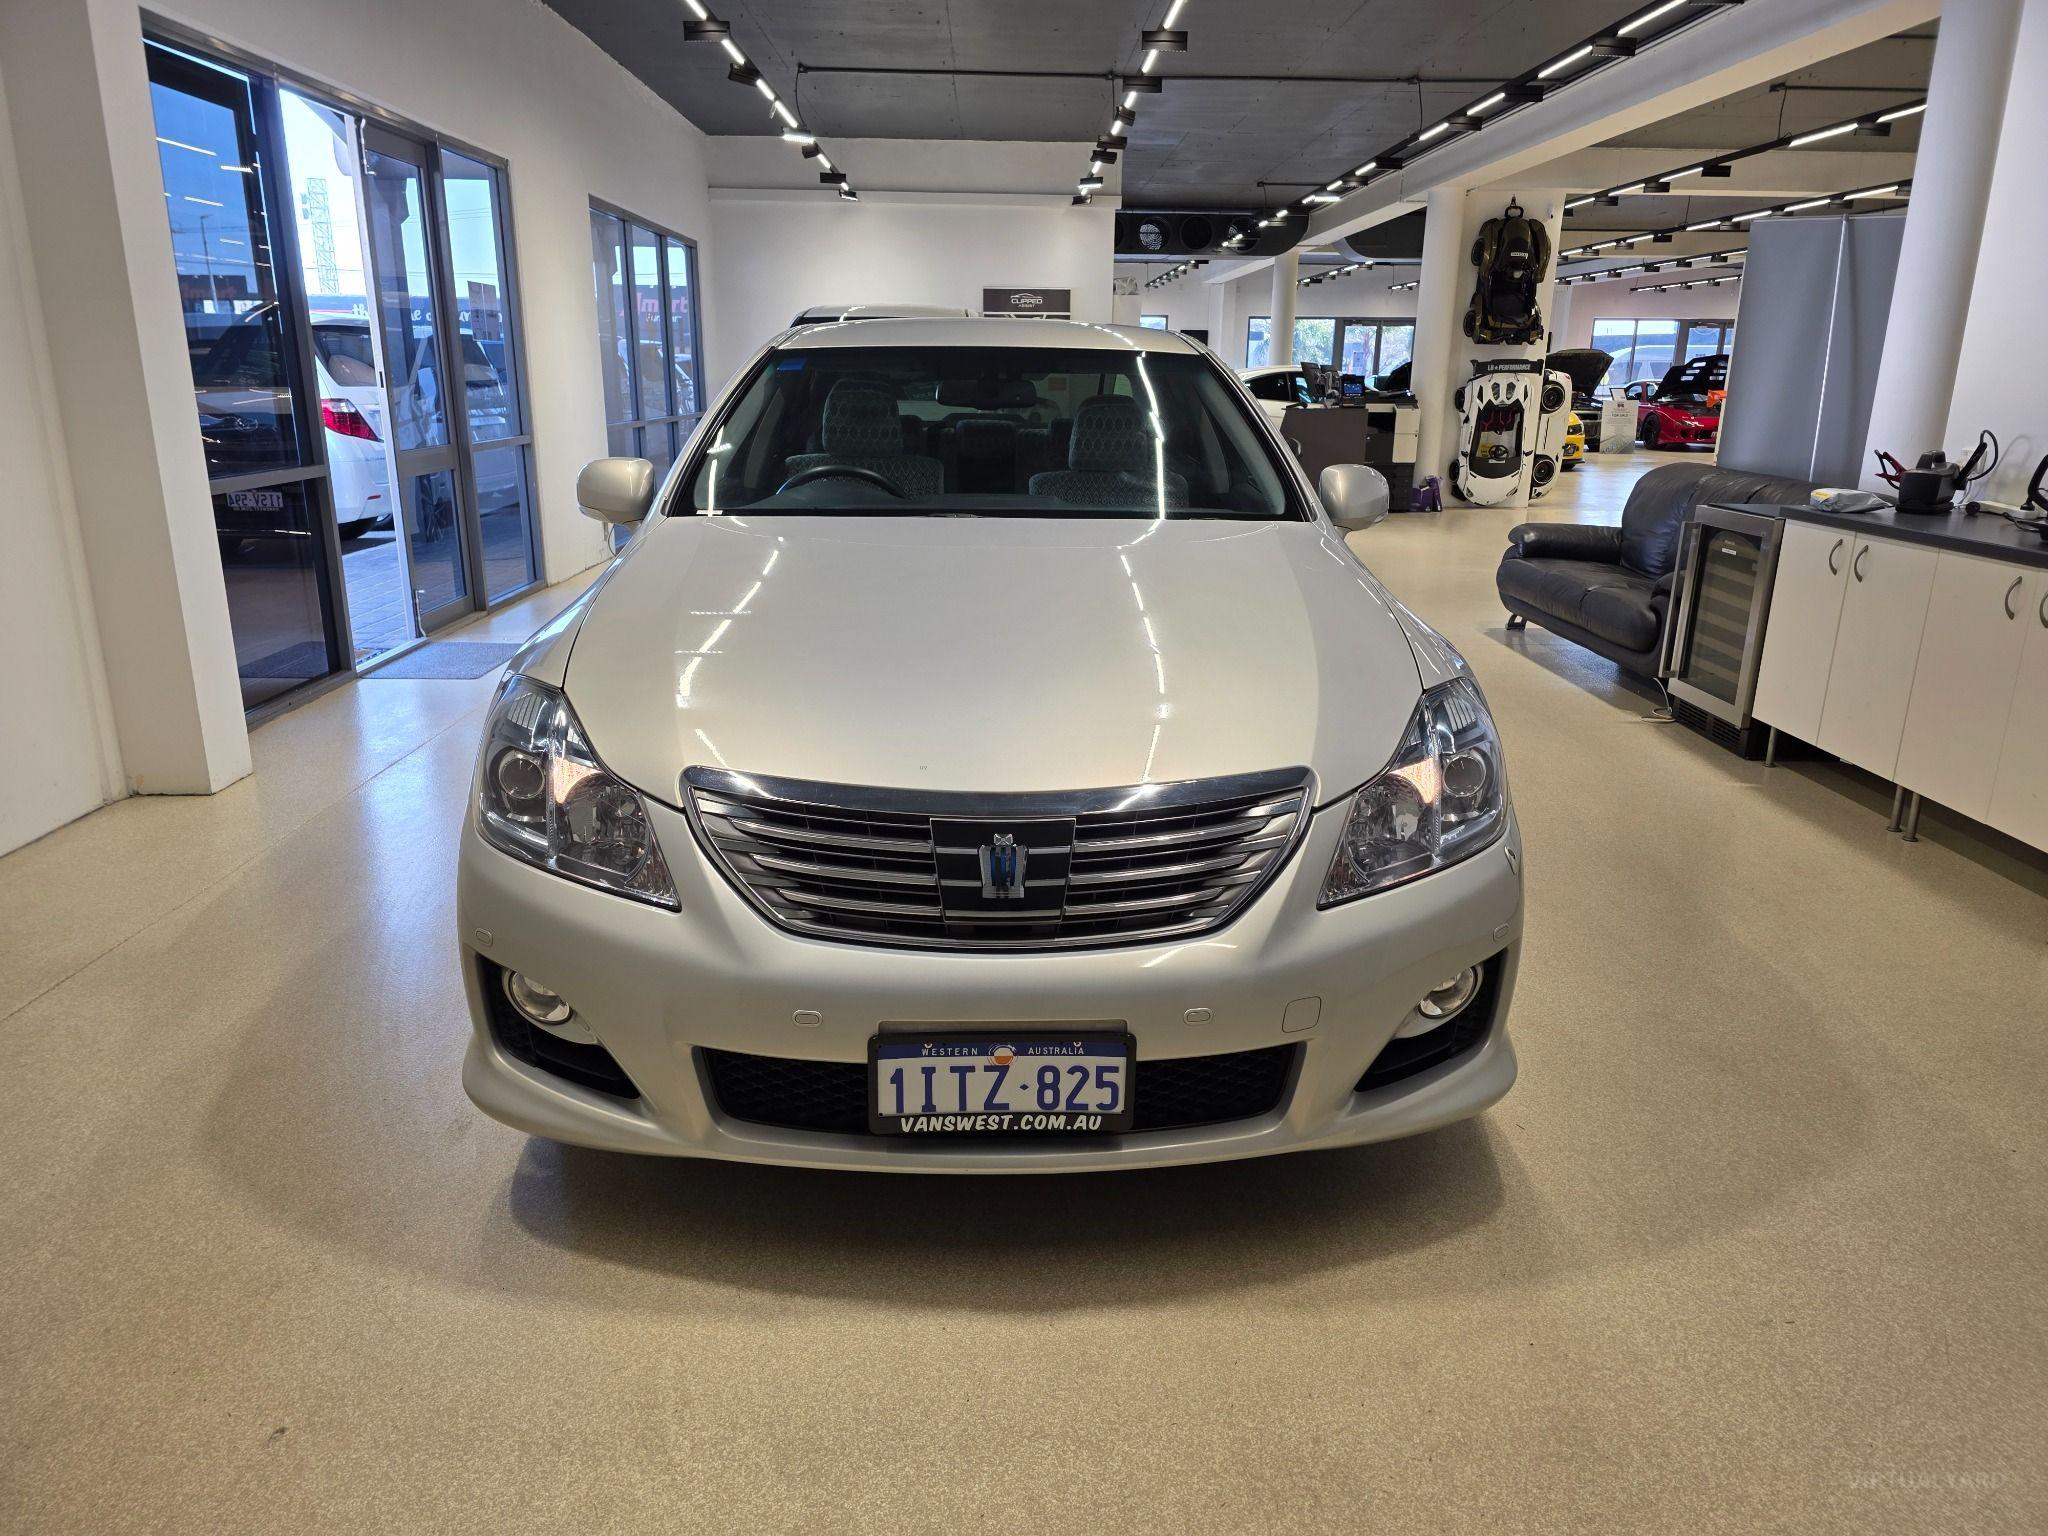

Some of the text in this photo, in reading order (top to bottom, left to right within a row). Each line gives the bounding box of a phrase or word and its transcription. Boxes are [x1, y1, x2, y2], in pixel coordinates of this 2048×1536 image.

[921, 1046, 1085, 1056] WESTERN AUSTRALIA
[900, 1114, 1102, 1133] VANSWEST.COM.AU
